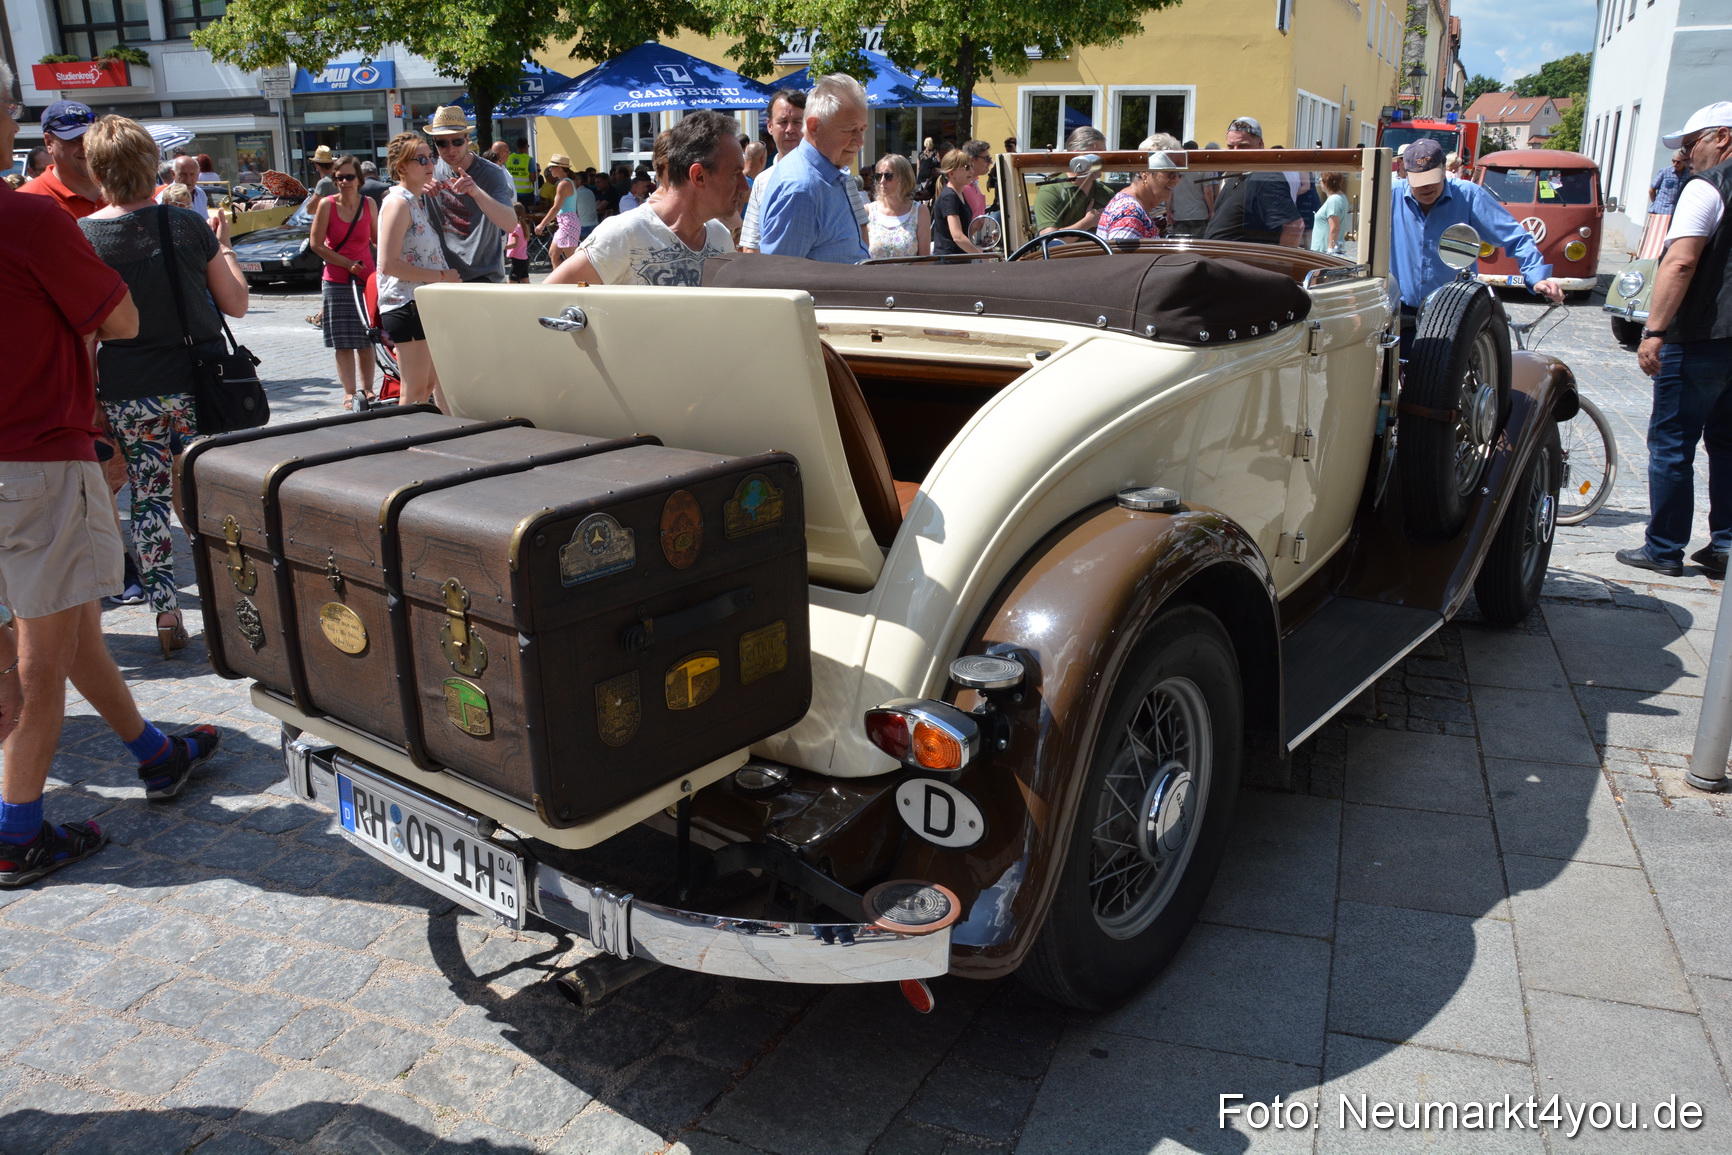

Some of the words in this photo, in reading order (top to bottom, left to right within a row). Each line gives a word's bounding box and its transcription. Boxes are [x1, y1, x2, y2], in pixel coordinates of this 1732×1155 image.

[56, 71, 95, 81] Studienkreis
[628, 87, 740, 99] GANSBRÄU
[1512, 276, 1524, 285] SU
[924, 784, 956, 838] D
[344, 807, 351, 820] D
[353, 786, 388, 845] RH
[406, 814, 445, 873] OD
[453, 838, 495, 900] 1H
[498, 857, 512, 875] 04
[500, 891, 514, 909] 10
